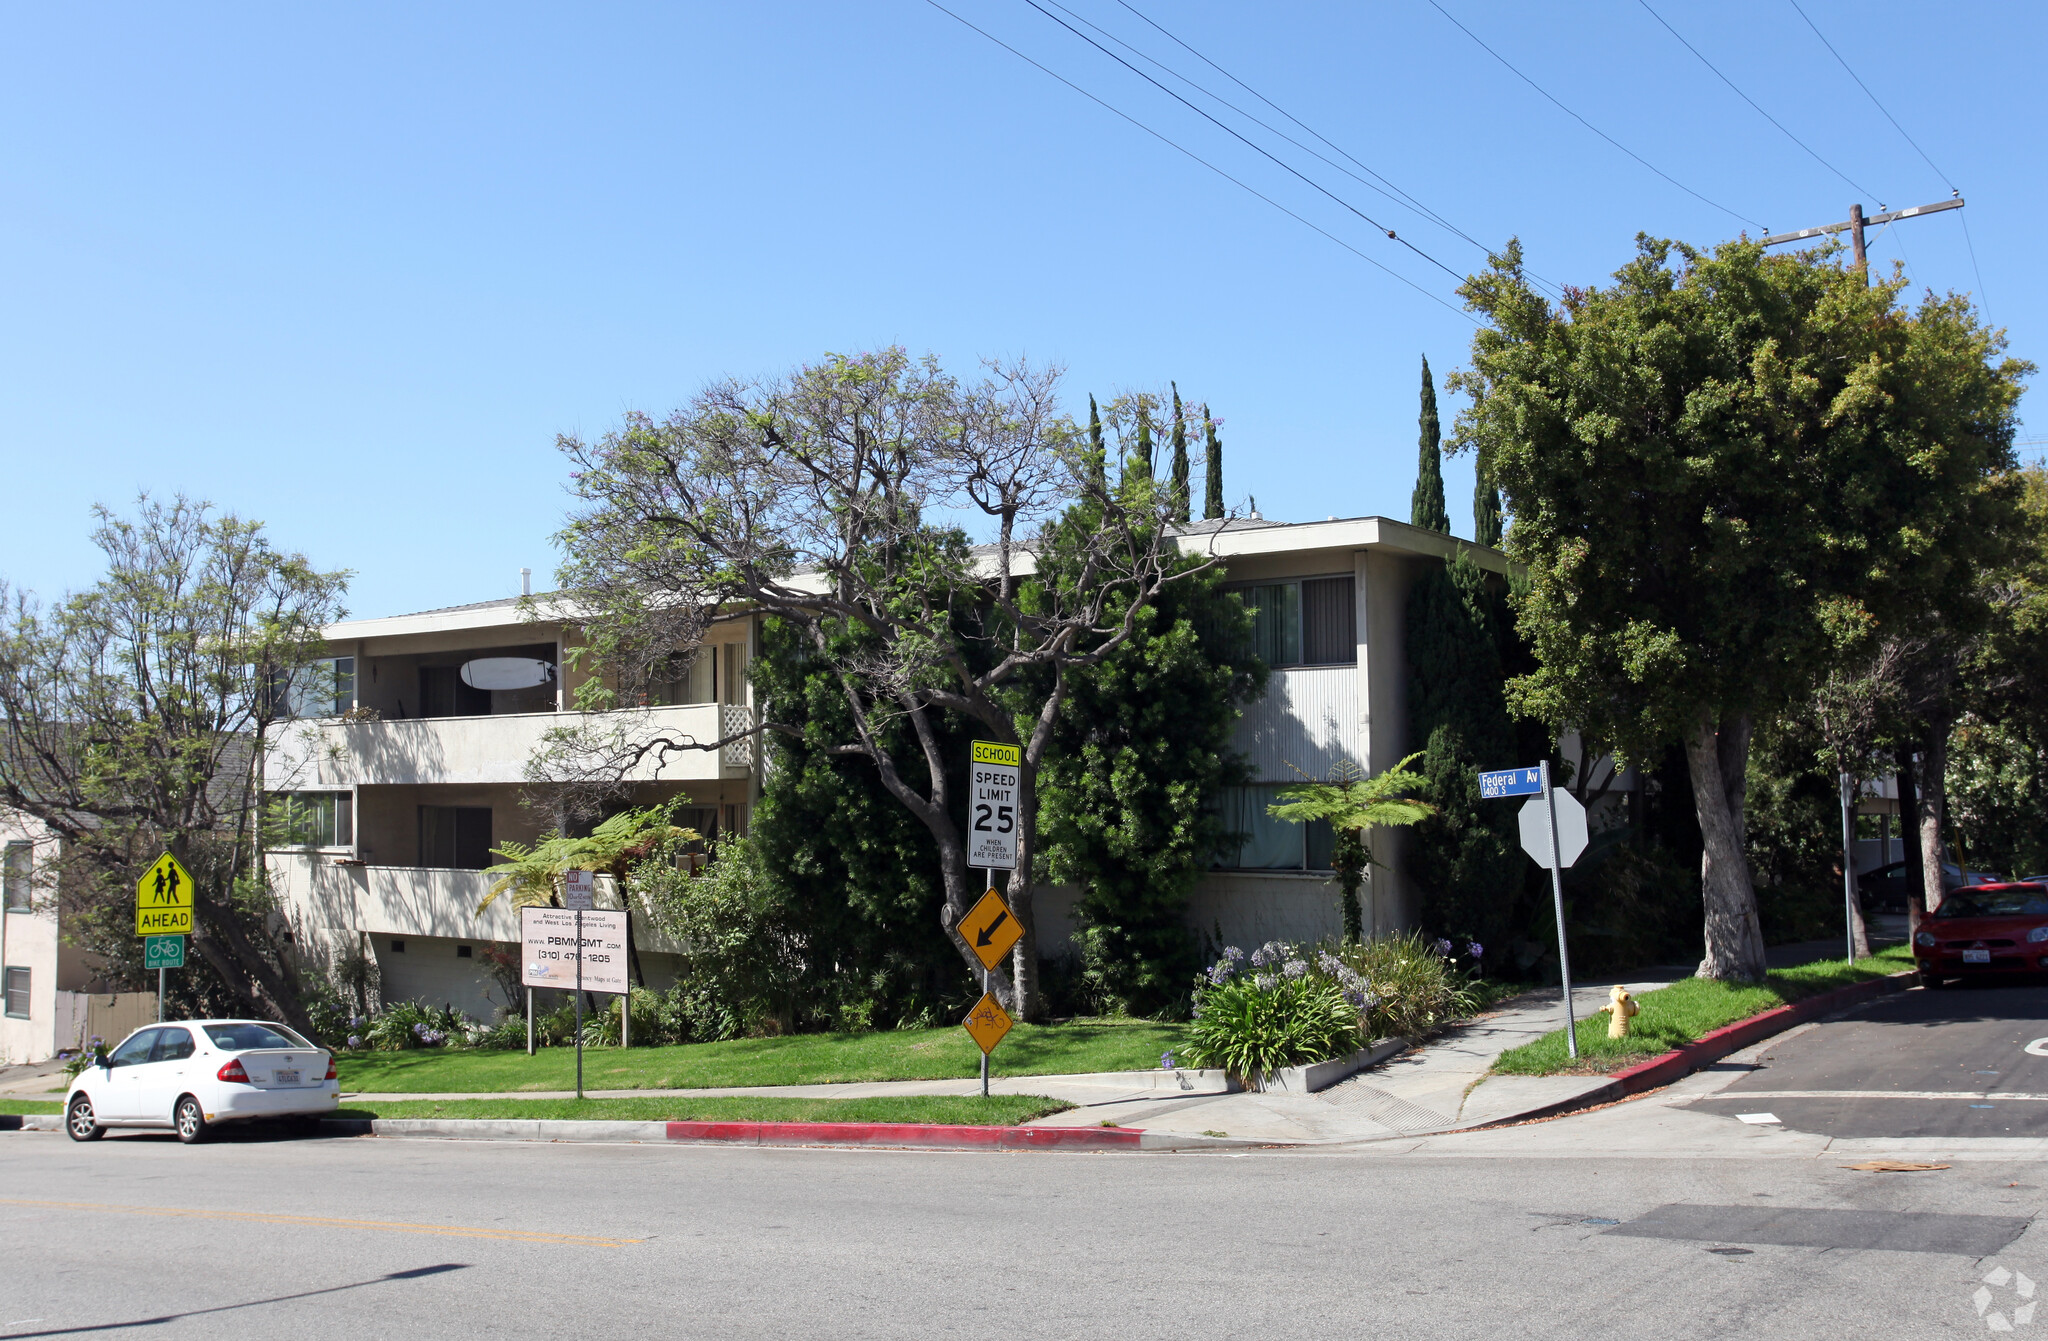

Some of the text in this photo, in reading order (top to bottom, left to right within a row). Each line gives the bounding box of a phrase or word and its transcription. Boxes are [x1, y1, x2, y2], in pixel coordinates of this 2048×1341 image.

[975, 746, 1017, 762] SCHOOL
[976, 772, 1016, 786] SPEED
[1482, 770, 1538, 787] Federal Av
[979, 788, 1011, 802] LIMIT
[1483, 786, 1506, 796] 1400 S
[974, 803, 1014, 834] 25
[568, 872, 578, 882] NO
[569, 884, 591, 892] PARKING
[142, 913, 188, 928] AHEAD
[574, 921, 597, 929] Ageles
[599, 922, 617, 930] Living
